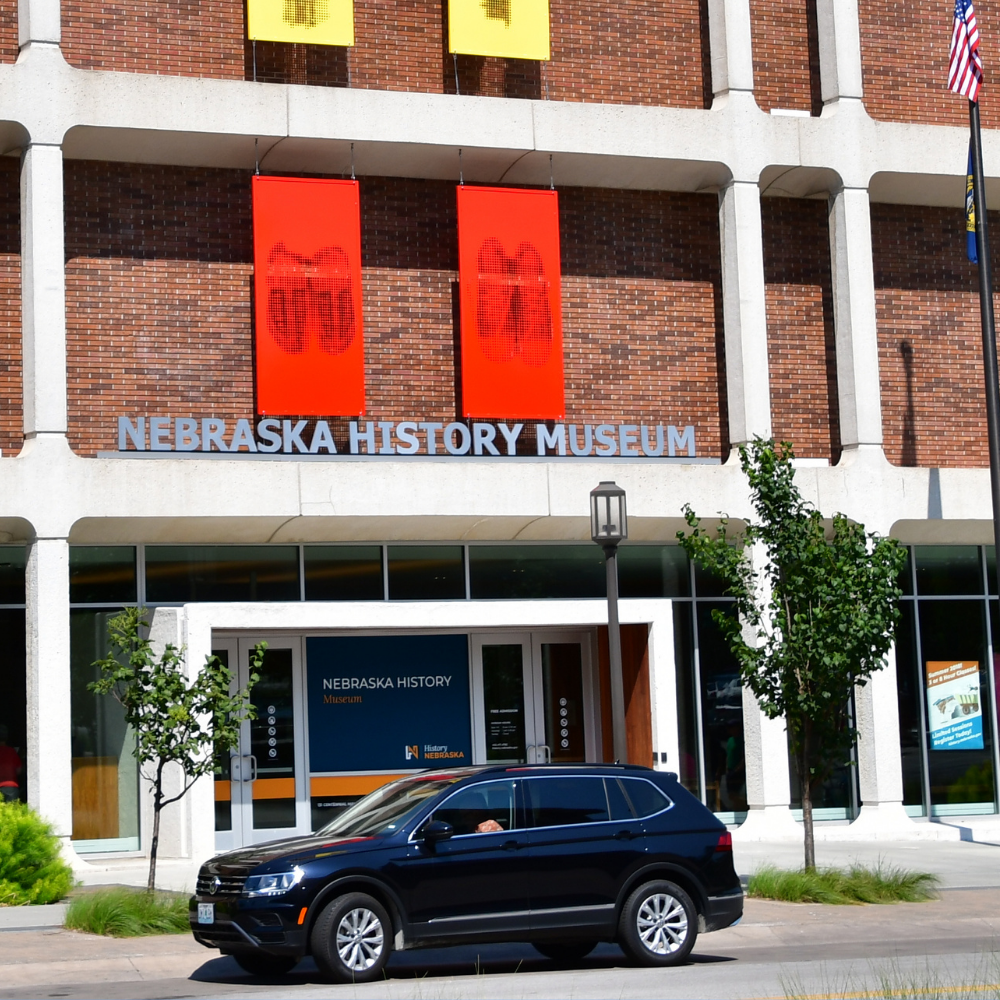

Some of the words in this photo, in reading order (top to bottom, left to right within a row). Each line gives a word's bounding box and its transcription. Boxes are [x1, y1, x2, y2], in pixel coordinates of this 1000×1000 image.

[117, 416, 338, 454] NEBRASKA
[349, 421, 521, 456] HISTORY
[536, 424, 697, 458] MUSEUM
[322, 677, 395, 690] NEBRASKA
[397, 675, 452, 688] HISTORY
[322, 694, 363, 704] Museum
[931, 727, 951, 740] Limited
[951, 721, 973, 733] Sessions
[933, 735, 955, 746] Register
[954, 728, 972, 739] Today!
[424, 744, 448, 753] History
[424, 751, 465, 760] NEBRASKA
